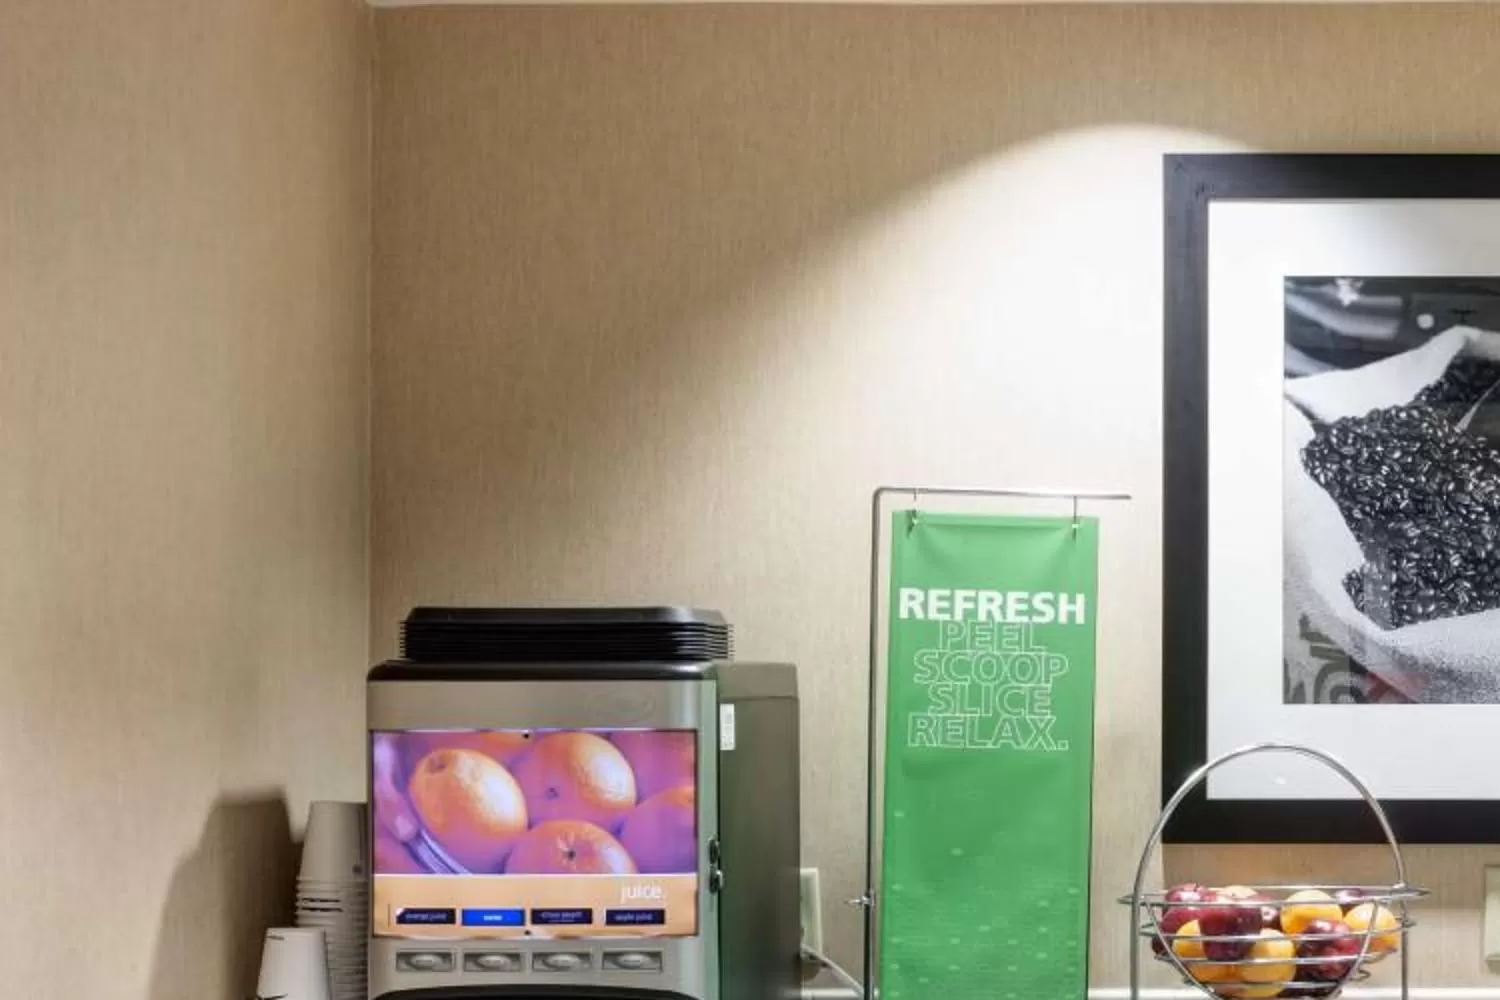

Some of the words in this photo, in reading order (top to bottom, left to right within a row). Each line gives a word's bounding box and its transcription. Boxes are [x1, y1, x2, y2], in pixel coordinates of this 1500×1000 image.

[899, 587, 1086, 625] REFRESH
[939, 619, 1048, 653] PEEL
[913, 650, 1069, 686] SCOOP
[928, 681, 1053, 718] SLICE
[907, 712, 1069, 751] RELAX.
[620, 883, 663, 904] juice
